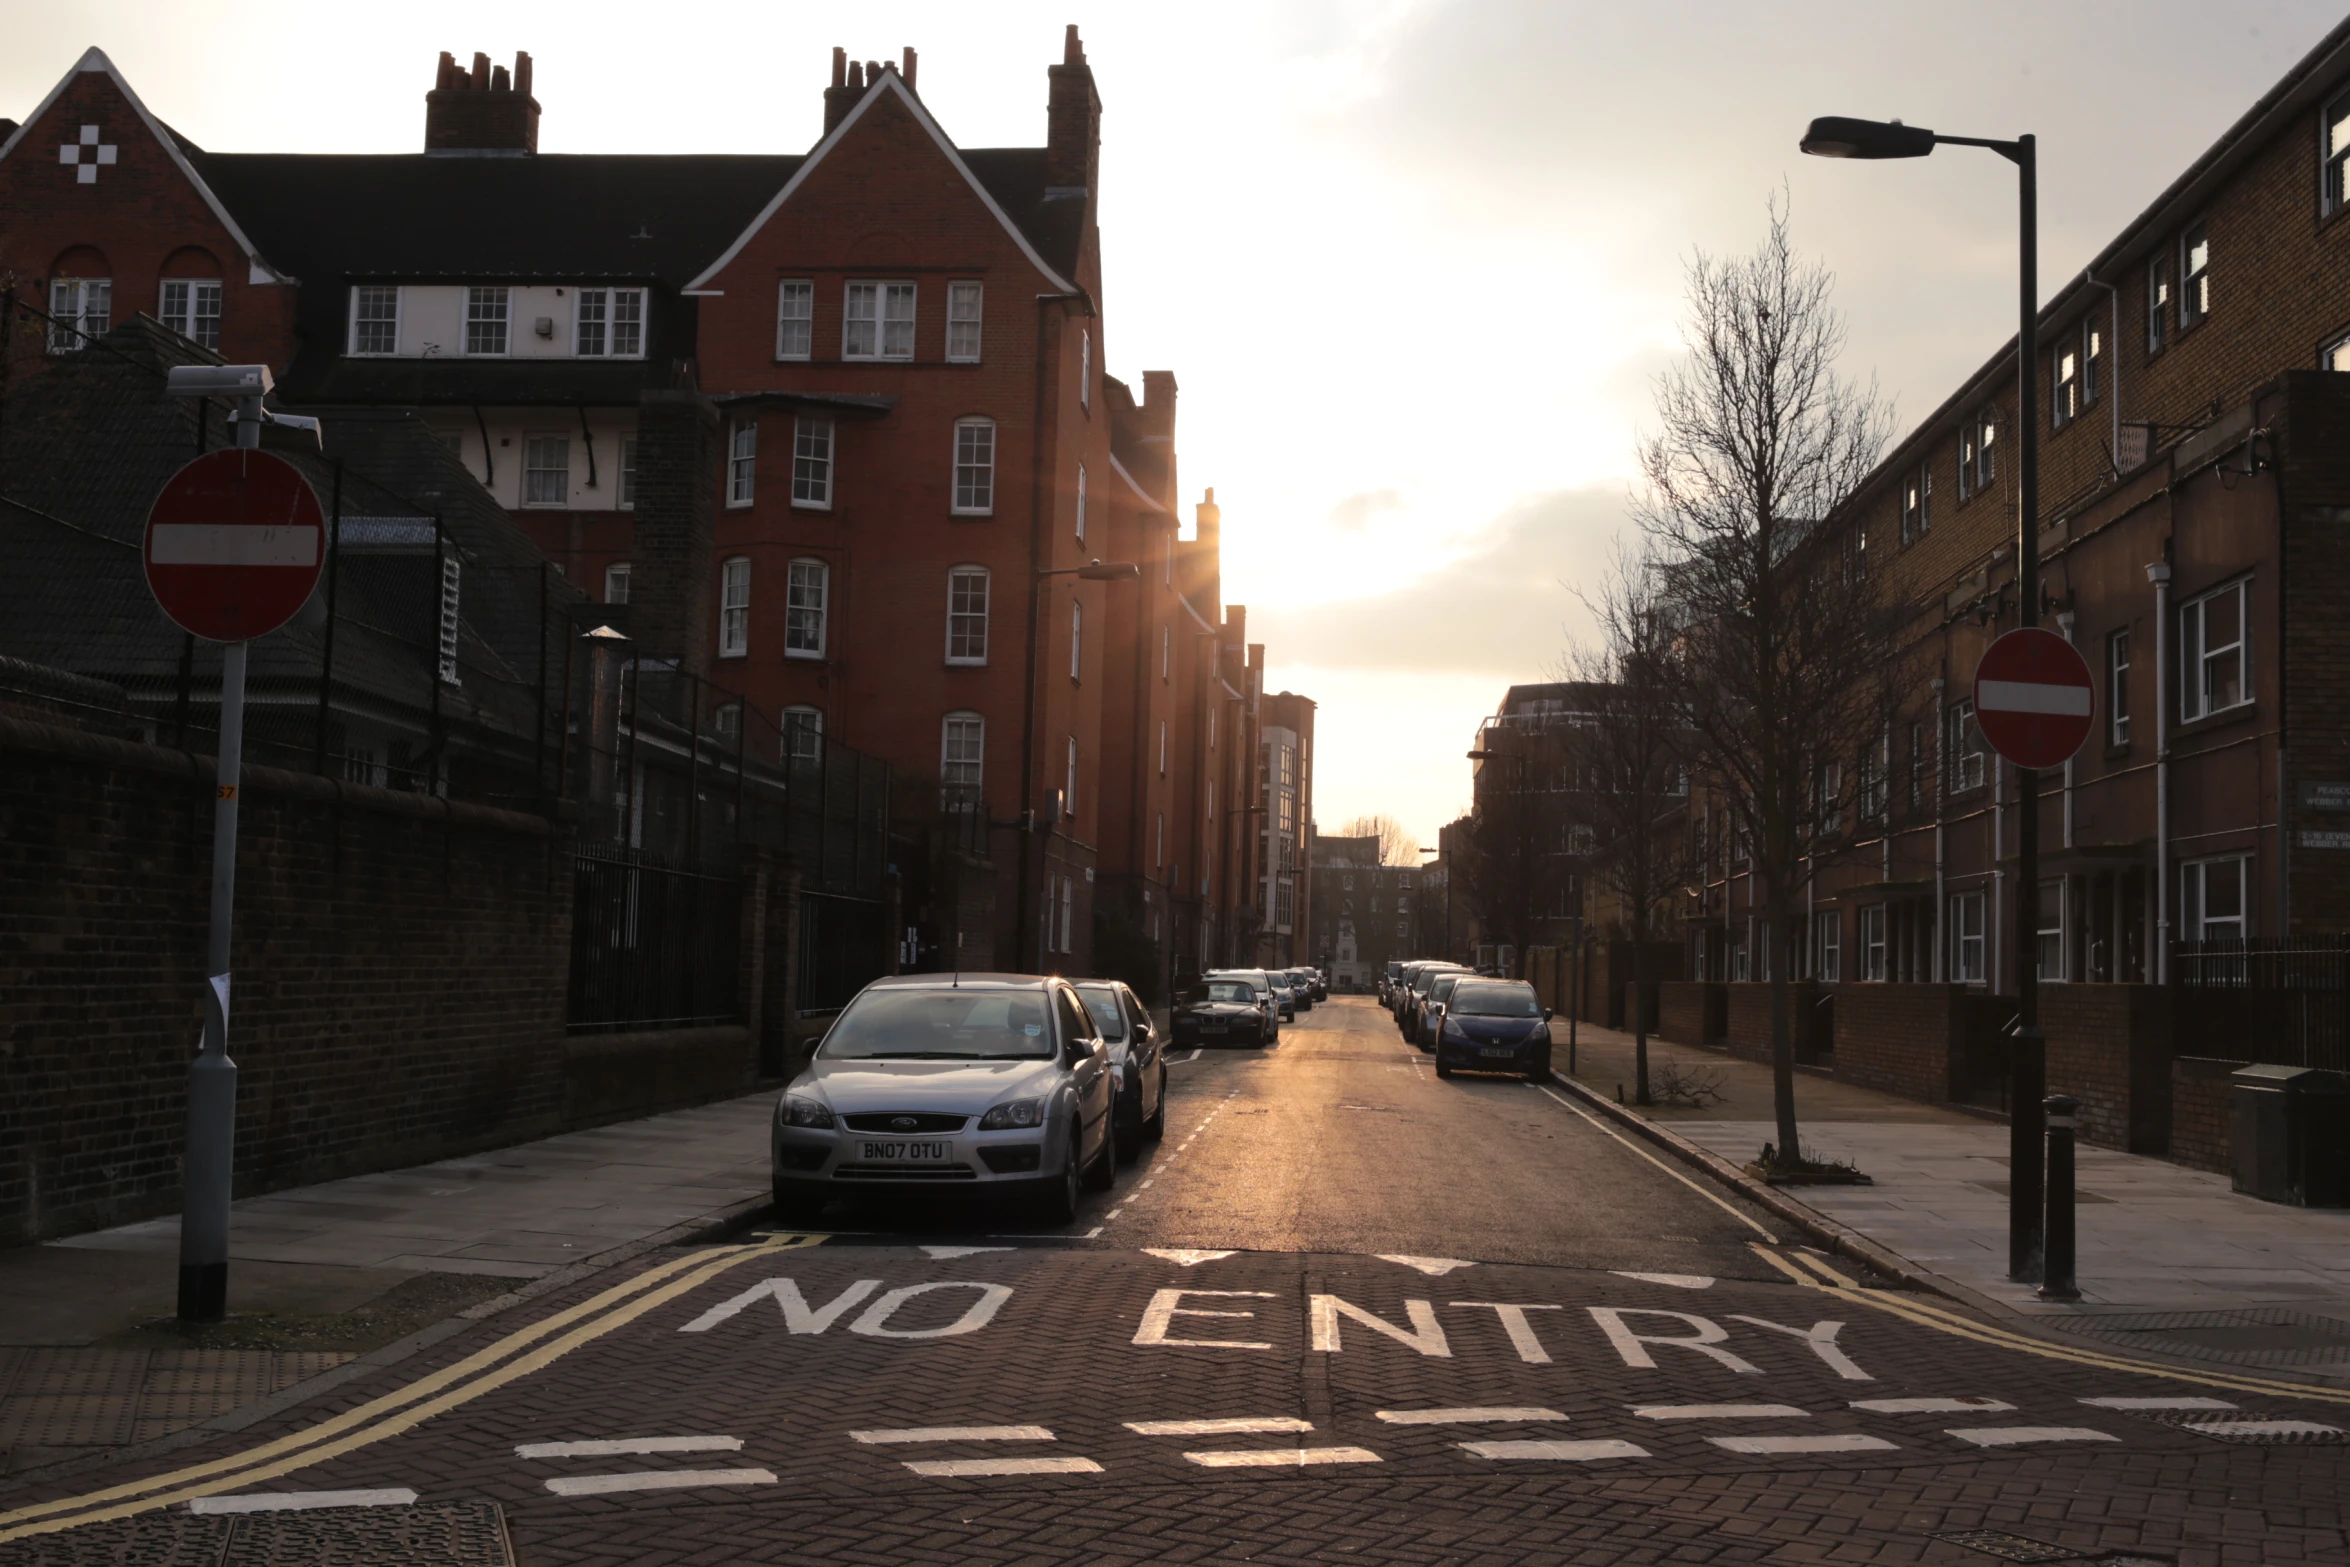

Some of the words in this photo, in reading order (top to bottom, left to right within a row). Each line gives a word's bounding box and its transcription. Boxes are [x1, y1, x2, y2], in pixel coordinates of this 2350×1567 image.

[216, 785, 235, 798] 57
[2305, 797, 2343, 805] WEBBER
[2302, 840, 2339, 848] WEBBER
[864, 1143, 906, 1158] BN07
[910, 1143, 943, 1158] OTU
[677, 1277, 1014, 1337] NO
[1130, 1287, 1877, 1382] ENTRY
